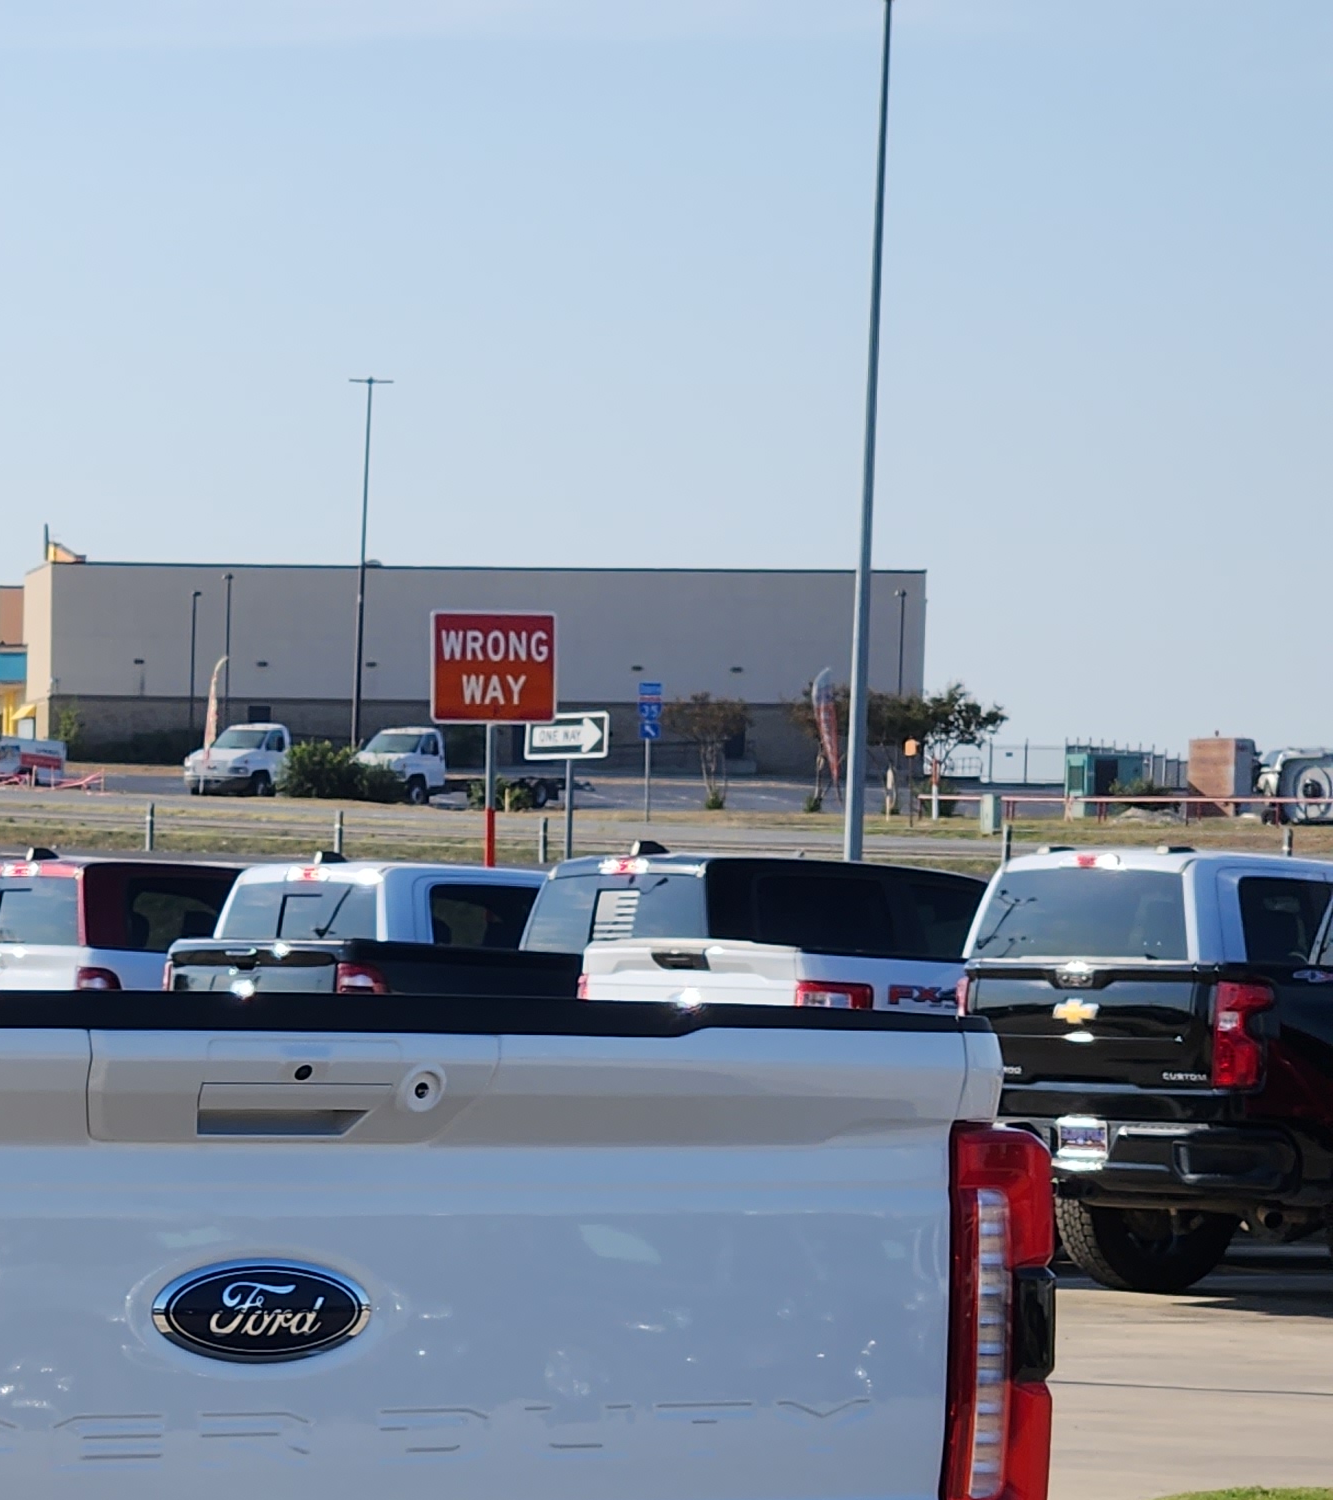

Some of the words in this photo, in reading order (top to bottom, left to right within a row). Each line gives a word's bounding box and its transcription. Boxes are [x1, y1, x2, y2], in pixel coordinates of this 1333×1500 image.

[441, 630, 549, 662] WRONG
[462, 674, 527, 705] WAY
[539, 730, 558, 742] ONE
[563, 729, 581, 741] WAY
[1162, 1071, 1207, 1081] CUSTOM
[210, 1281, 325, 1336] Ford
